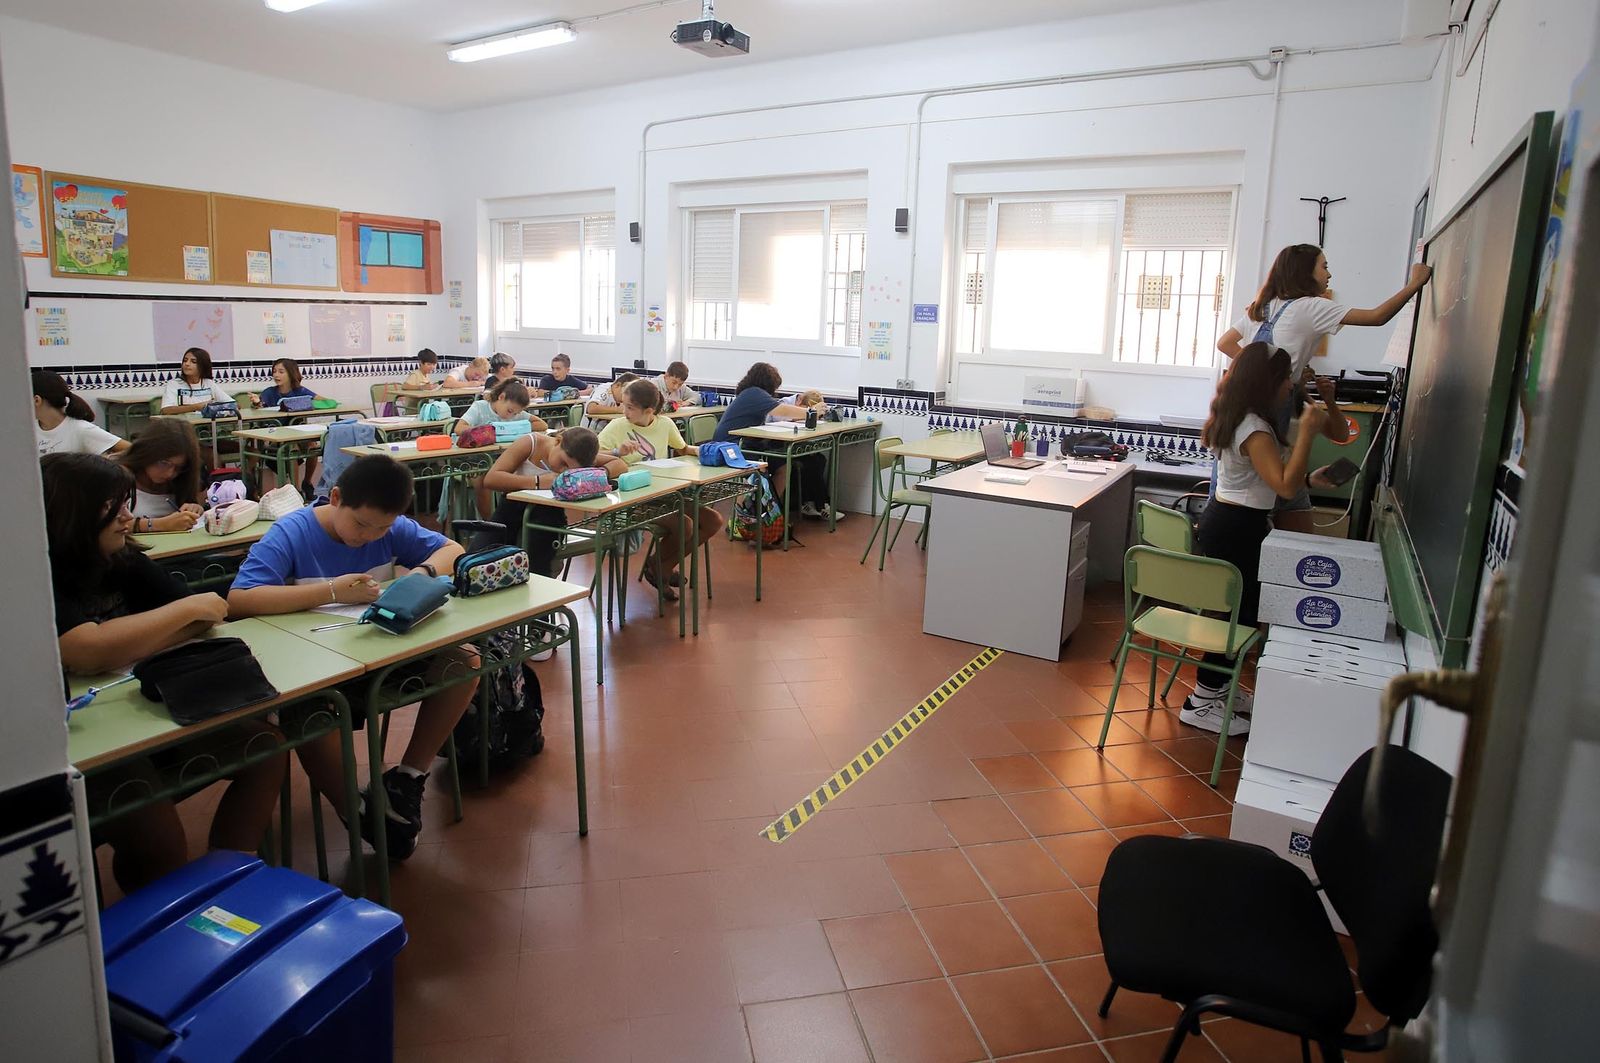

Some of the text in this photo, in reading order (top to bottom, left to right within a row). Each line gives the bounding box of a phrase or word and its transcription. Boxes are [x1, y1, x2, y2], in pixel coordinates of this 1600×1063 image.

[1305, 558, 1316, 566] La
[1317, 560, 1334, 570] Caja
[1305, 599, 1316, 607] La
[1317, 600, 1334, 610] Caja
